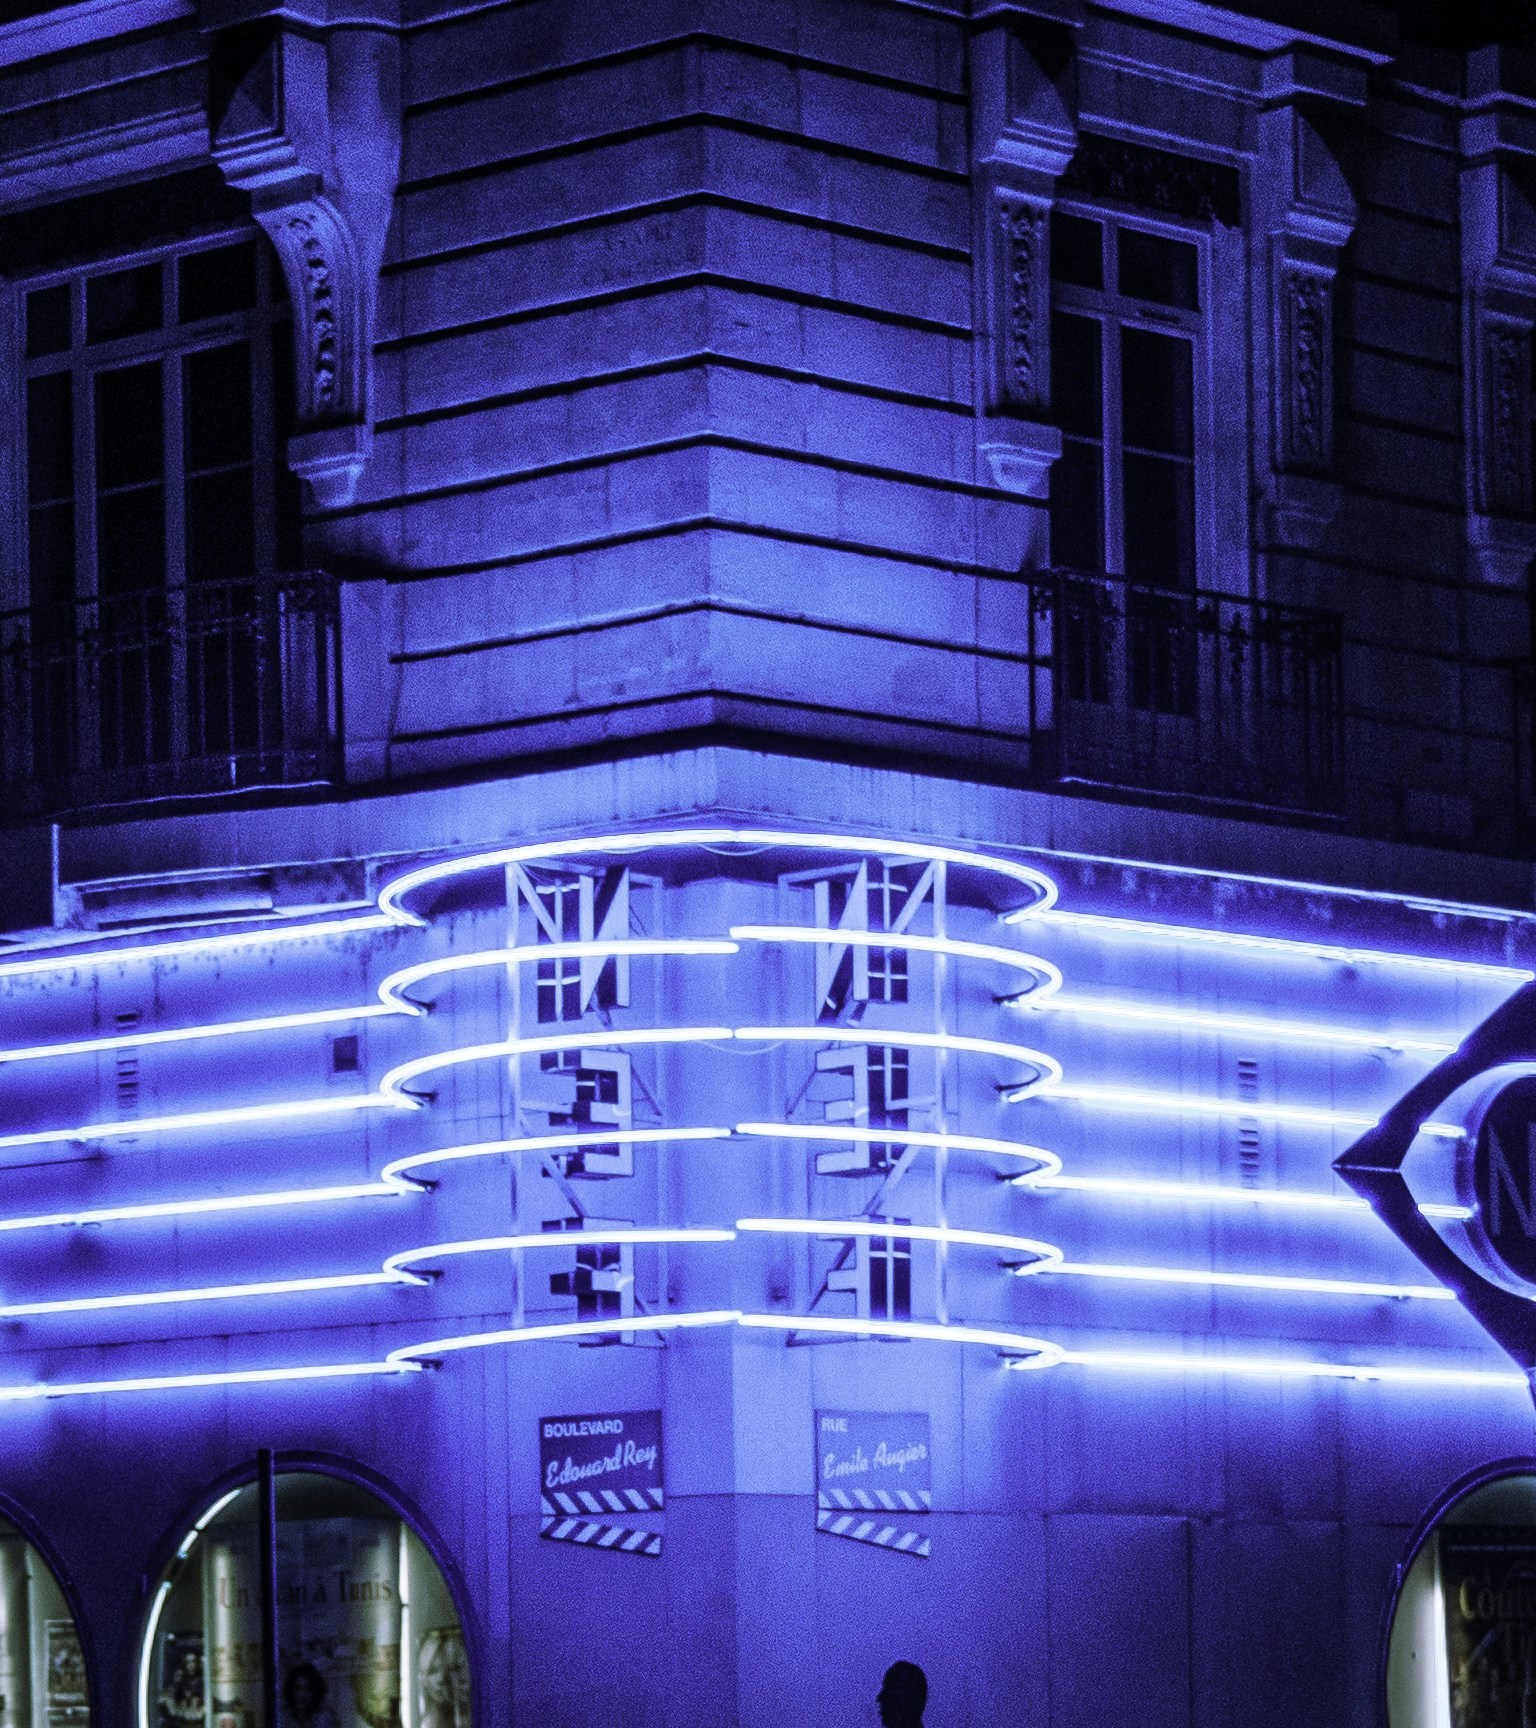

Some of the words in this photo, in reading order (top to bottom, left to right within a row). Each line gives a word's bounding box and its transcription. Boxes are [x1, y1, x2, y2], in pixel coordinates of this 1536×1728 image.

[543, 1418, 624, 1438] BOULEVARD
[821, 1417, 848, 1433] RUE
[545, 1442, 623, 1488] Edouard
[623, 1439, 657, 1471] Rey
